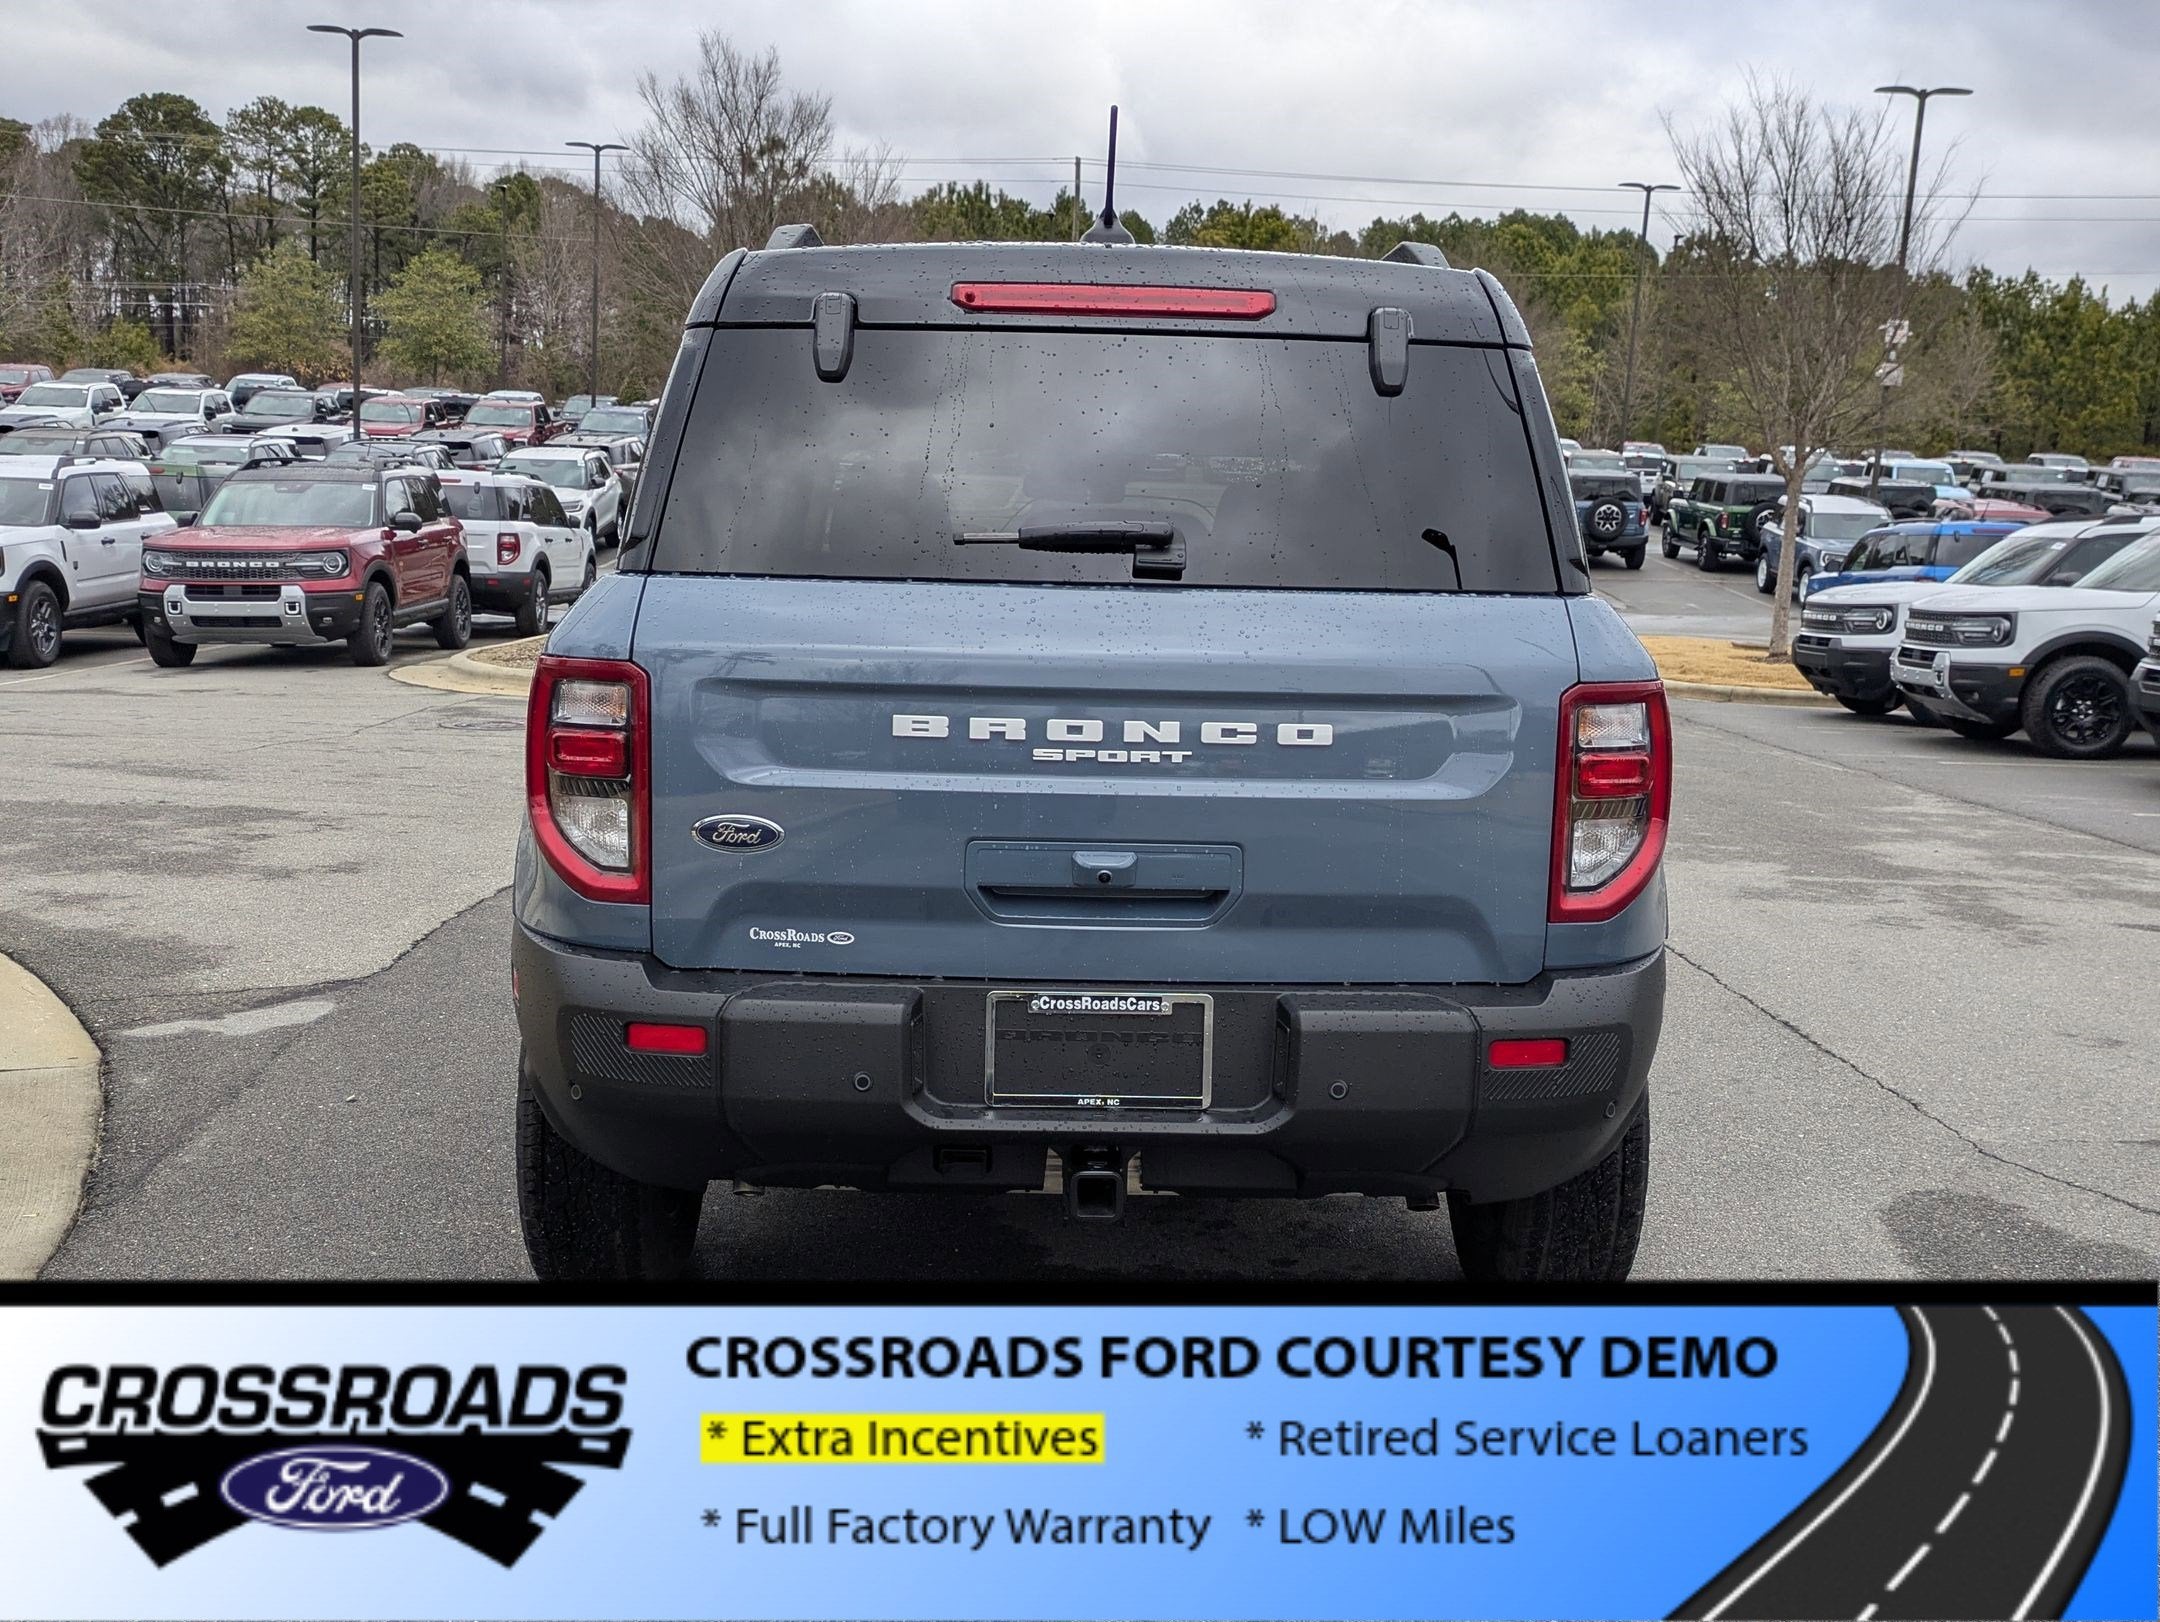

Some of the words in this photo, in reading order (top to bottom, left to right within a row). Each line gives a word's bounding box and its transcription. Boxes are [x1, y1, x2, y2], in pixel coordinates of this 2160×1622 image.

[186, 560, 280, 568] BRONCO
[892, 714, 1334, 746] BRONCO
[1032, 748, 1193, 763] SPORT
[712, 821, 762, 844] Ford
[1039, 996, 1160, 1011] CrossRoadsCars
